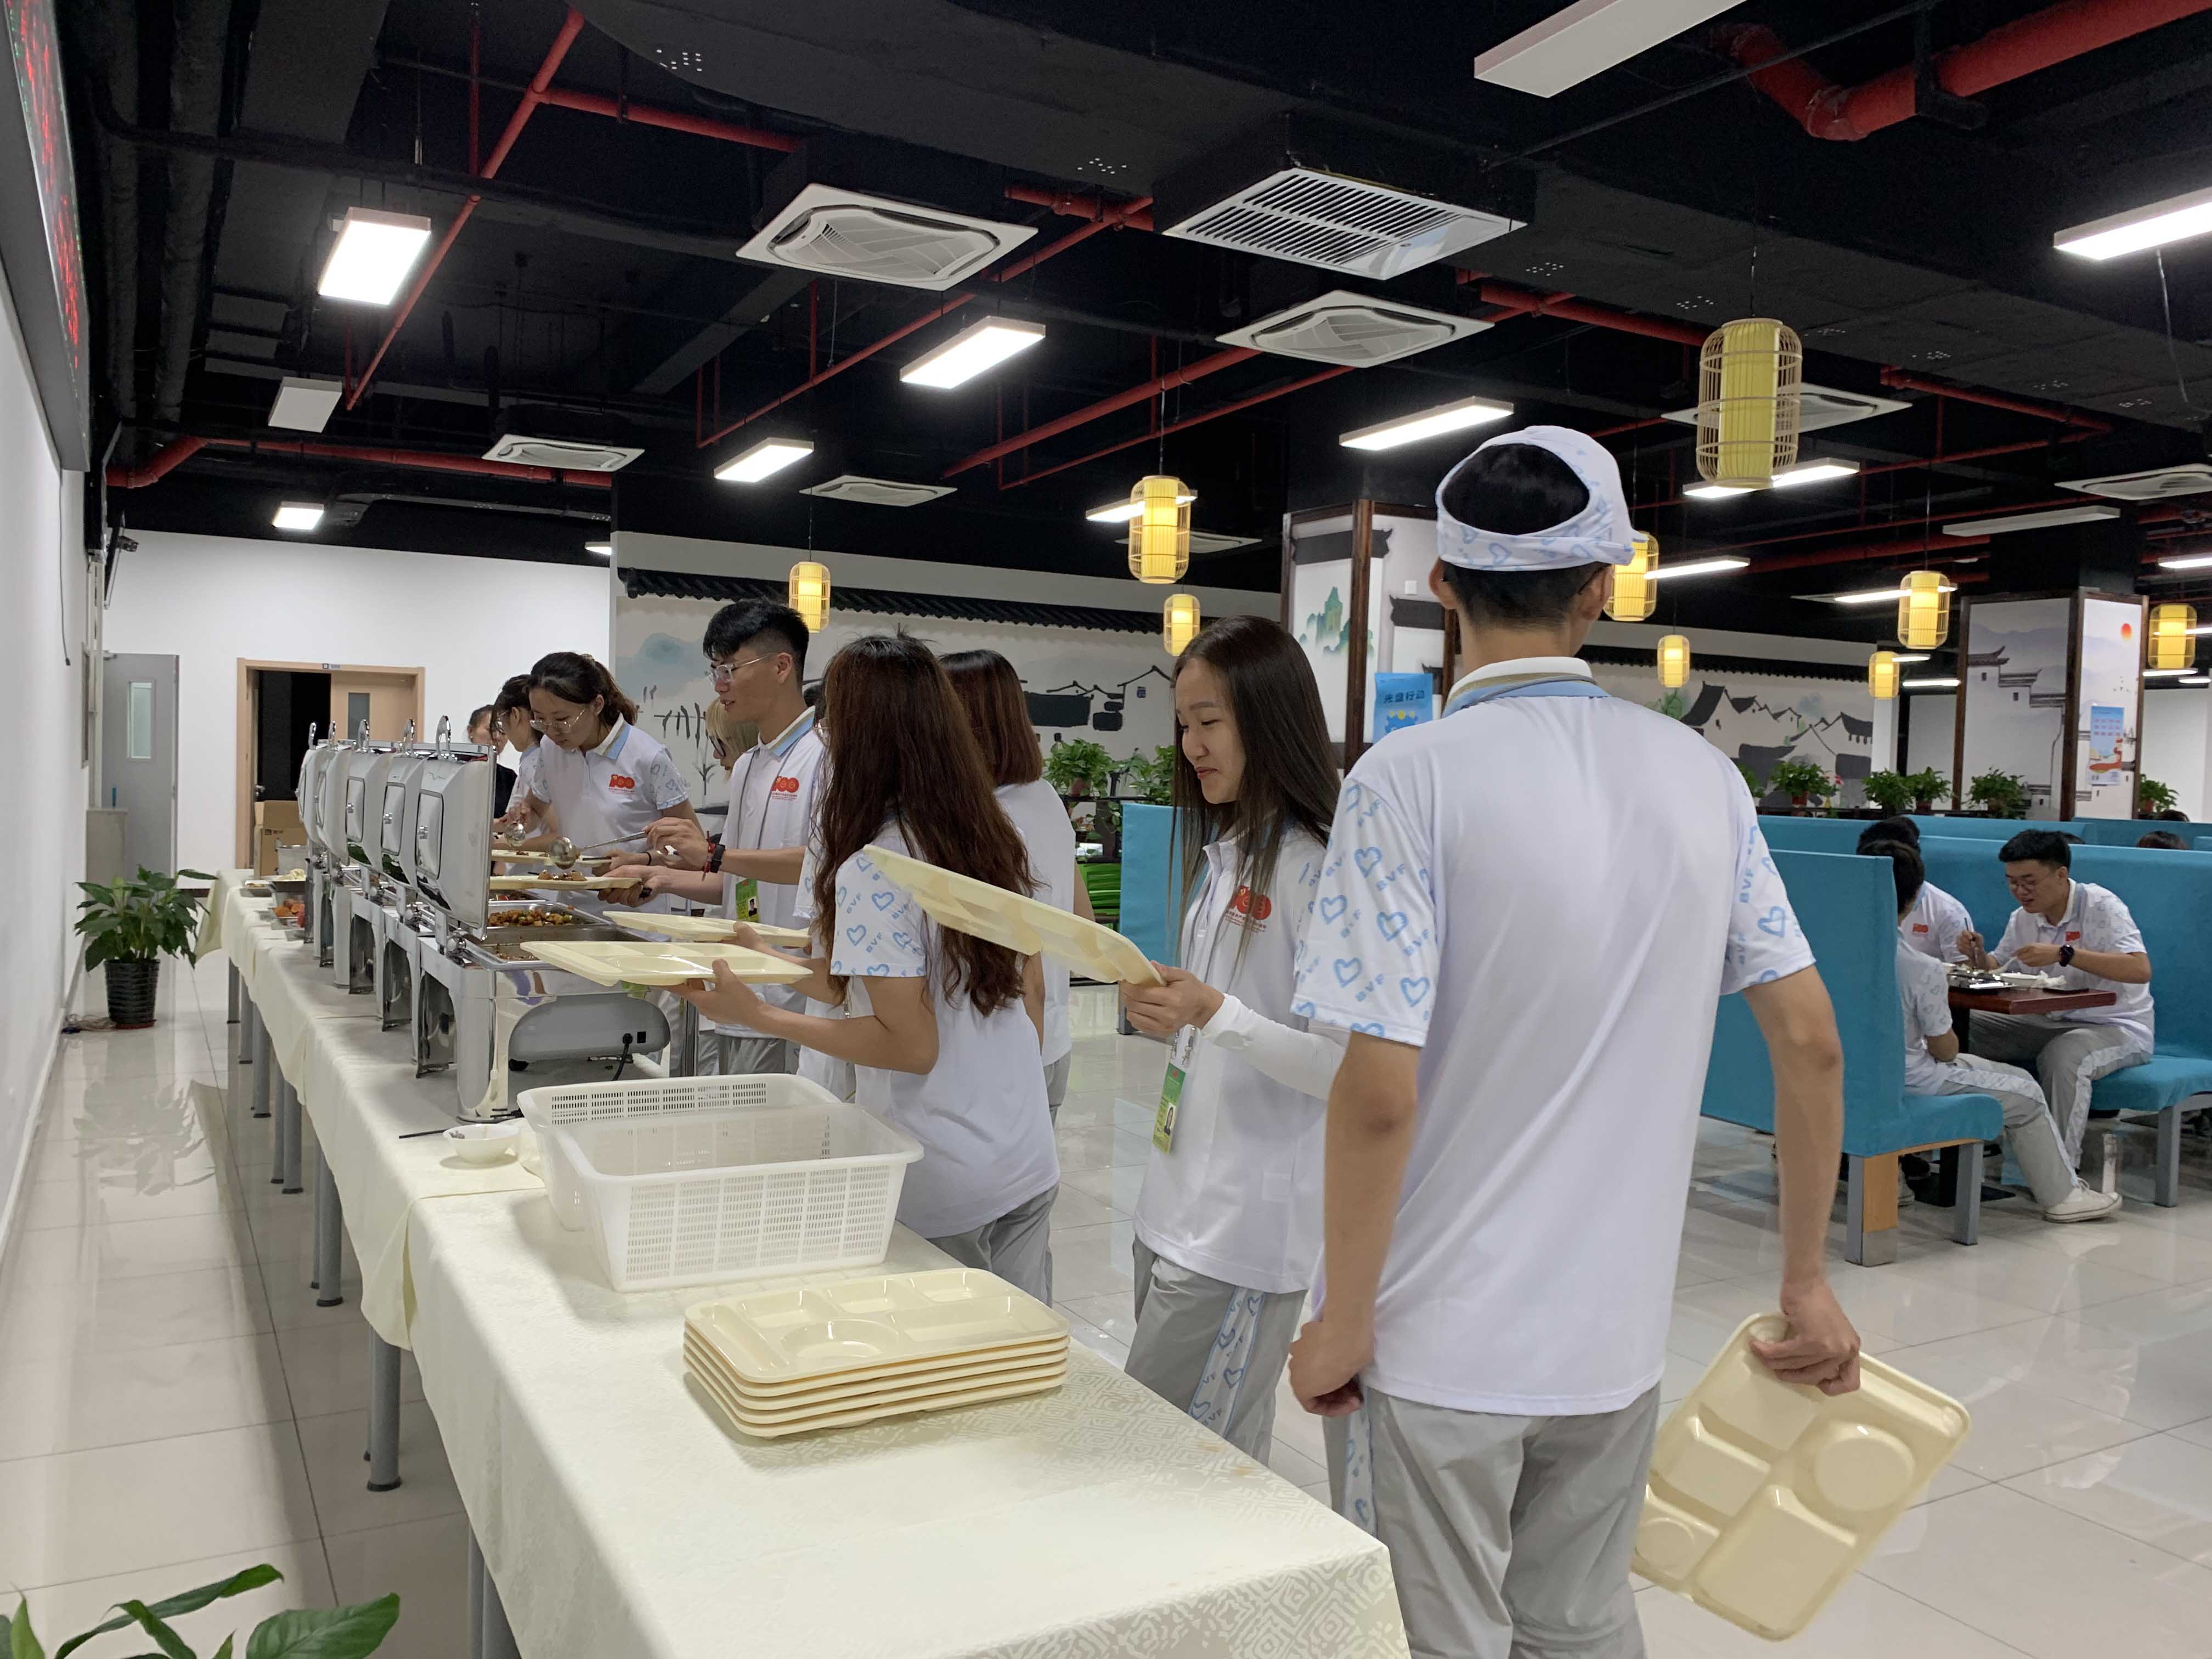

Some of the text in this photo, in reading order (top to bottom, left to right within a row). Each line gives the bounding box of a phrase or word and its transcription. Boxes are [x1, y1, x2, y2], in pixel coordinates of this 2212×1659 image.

[1384, 690, 1425, 703] 光盘行动
[1376, 863, 1405, 897] BVF
[1739, 868, 1754, 904] BVF
[847, 891, 862, 915] BVF
[866, 932, 883, 953] BVF
[1404, 929, 1430, 956] BVF
[1355, 973, 1385, 1002] BVF
